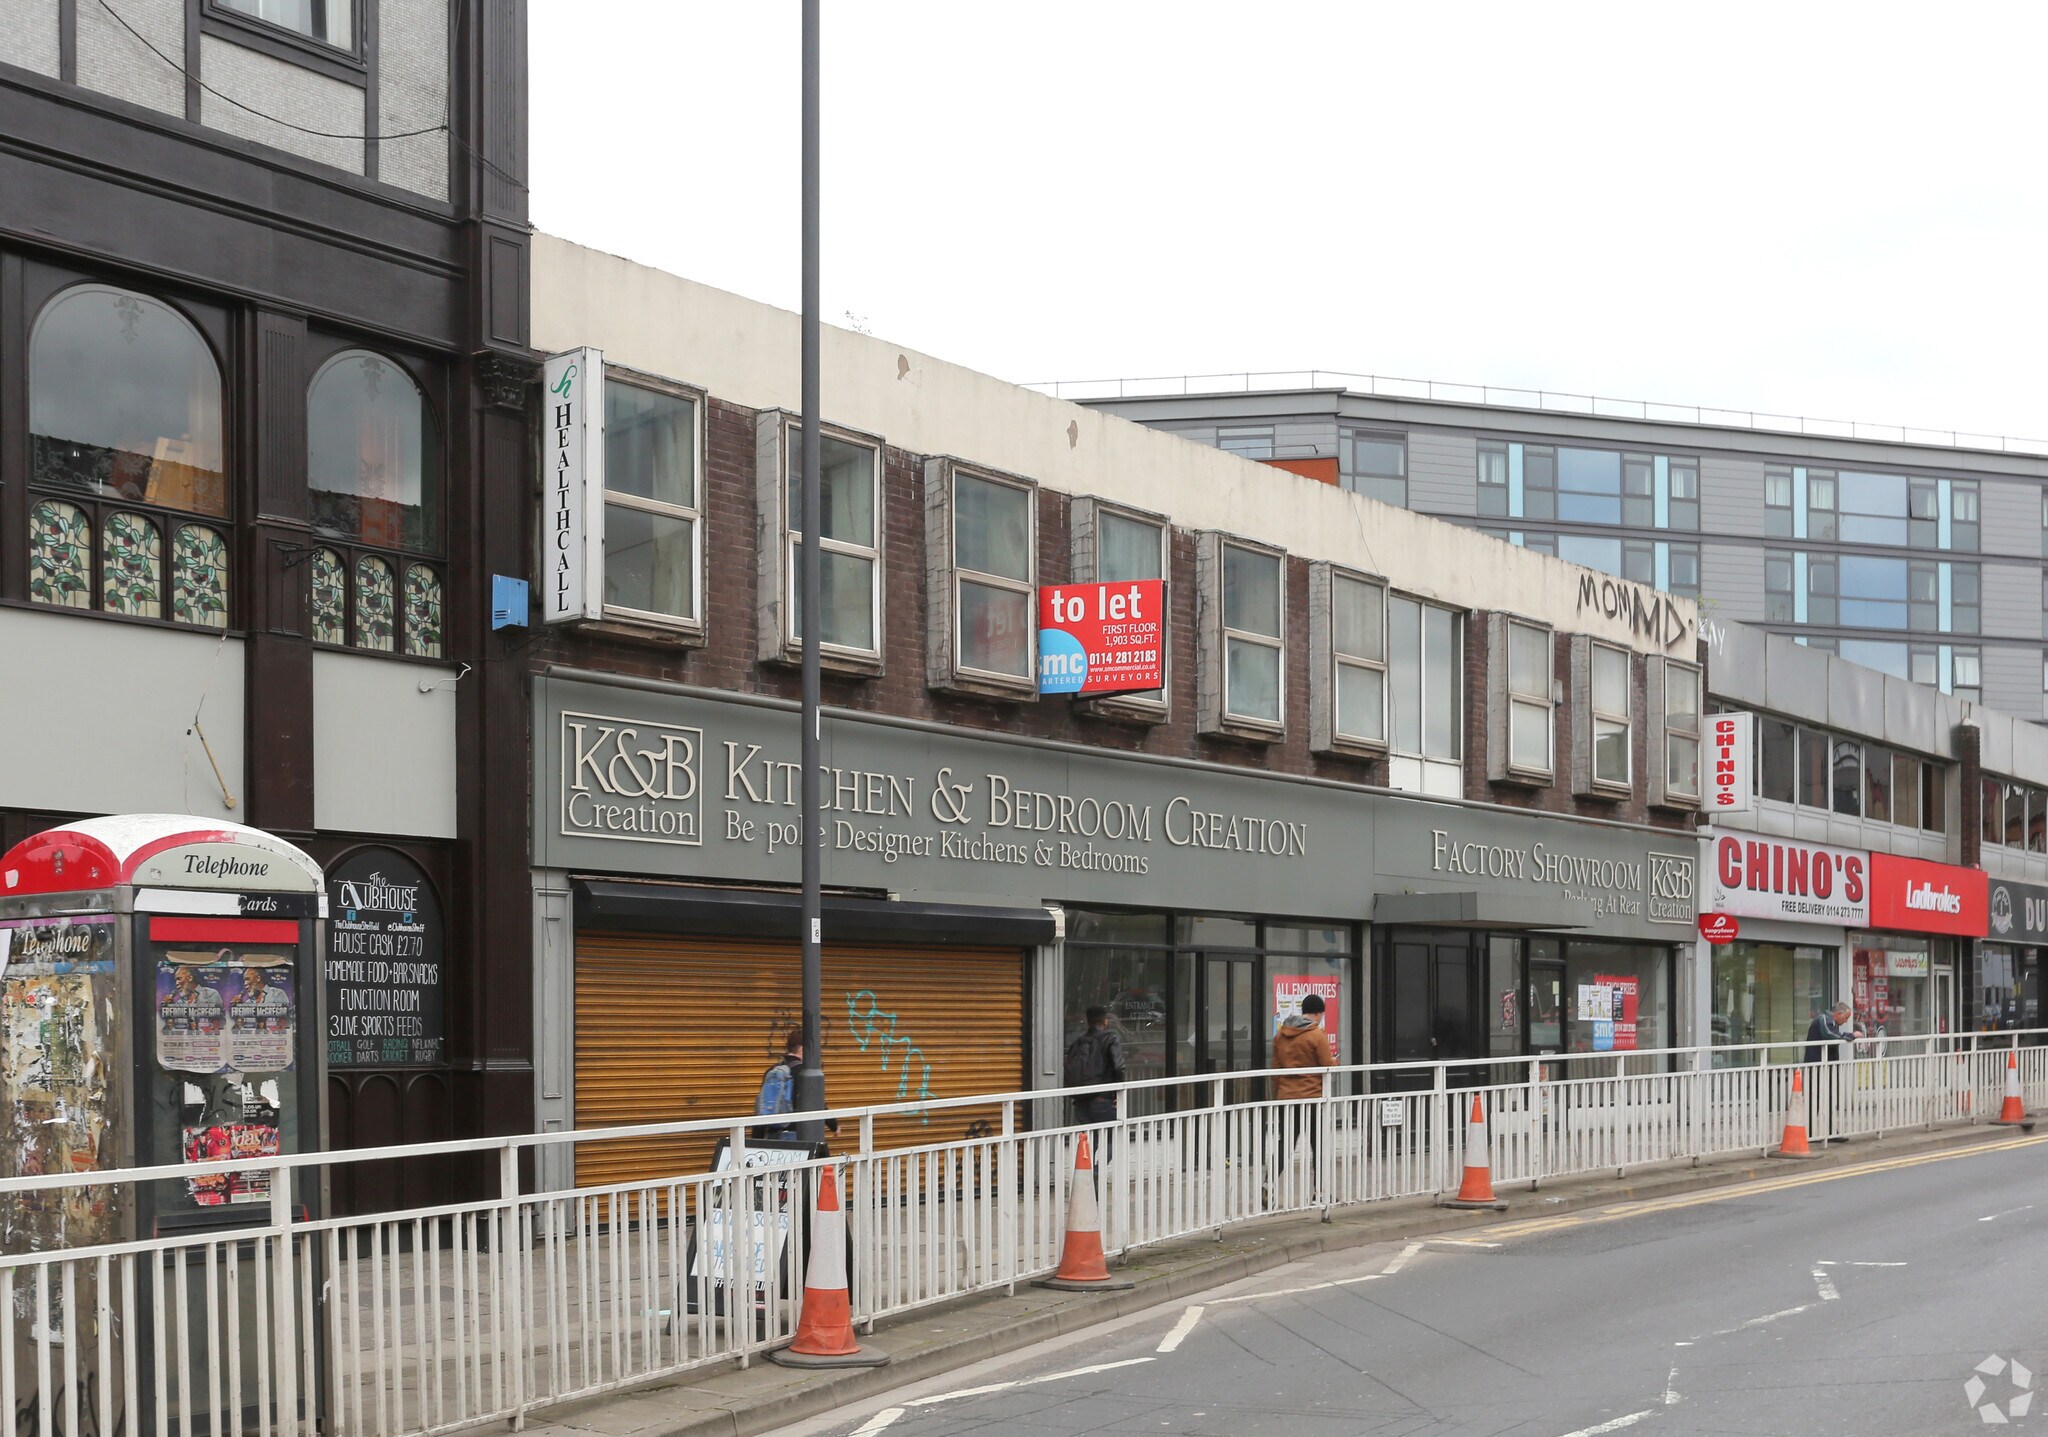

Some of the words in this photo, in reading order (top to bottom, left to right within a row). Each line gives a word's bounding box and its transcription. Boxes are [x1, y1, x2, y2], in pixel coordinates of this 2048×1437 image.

[555, 401, 572, 612] HEALTHCALL
[1051, 590, 1085, 623] to
[1098, 585, 1142, 620] let
[1102, 624, 1127, 635] FIRST
[1105, 635, 1128, 647] 1,903
[1129, 634, 1156, 645] SQ.FT.
[1089, 652, 1112, 665] 0114
[1115, 651, 1132, 664] 281
[1133, 650, 1157, 662] 2183
[1042, 676, 1084, 685] ARTERED
[1088, 672, 1158, 683] SURVEYORS
[568, 722, 697, 800] K&B
[1715, 720, 1735, 805] CHINO'S
[568, 792, 697, 837] Creation
[931, 767, 973, 824] &
[987, 774, 1152, 842] BEDROOM
[1165, 796, 1307, 857] CREATION
[835, 820, 934, 863] Designer
[940, 830, 1028, 866] Kitchens
[1033, 838, 1054, 867] &
[1059, 841, 1149, 875] Bedrooms
[184, 855, 269, 878] Telephone
[1432, 829, 1527, 879] FACTORY
[1532, 842, 1642, 892] SHOWROOM
[1718, 836, 1863, 903] CHINO'S
[369, 872, 390, 888] The
[1650, 858, 1693, 900] K&B
[1620, 895, 1641, 915] Rear
[1649, 896, 1692, 919] Creation
[1905, 880, 1961, 914] Ladbrokes
[1781, 901, 1796, 912] FREE
[1797, 902, 1825, 915] DELIVERY
[1826, 905, 1839, 916] 0114
[1851, 907, 1864, 919] 7777
[2025, 897, 2048, 932] DU
[334, 932, 366, 954] HOUSE
[369, 934, 394, 956] CASK
[396, 935, 423, 957] £2.70
[324, 960, 366, 982] HOMEMADE
[367, 962, 389, 983] FOOD
[340, 988, 391, 1011] FUNCTION
[393, 989, 420, 1012] ROOM
[1276, 983, 1289, 997] ALL
[1291, 983, 1336, 998] ENQUIRIES
[1125, 1001, 1155, 1010] ENTRANCE
[340, 1016, 358, 1036] LIVE
[361, 1016, 394, 1036] SPORTS
[396, 1016, 422, 1037] FEEDS
[1595, 1024, 1614, 1037] smc
[328, 1041, 351, 1052] OTBALL
[356, 1039, 374, 1050] GOLF
[383, 1039, 408, 1050] RACING
[328, 1052, 352, 1063] OOKER
[356, 1050, 379, 1063] DARTS
[382, 1050, 409, 1062] CRICKET
[414, 1050, 436, 1062] RUGBY
